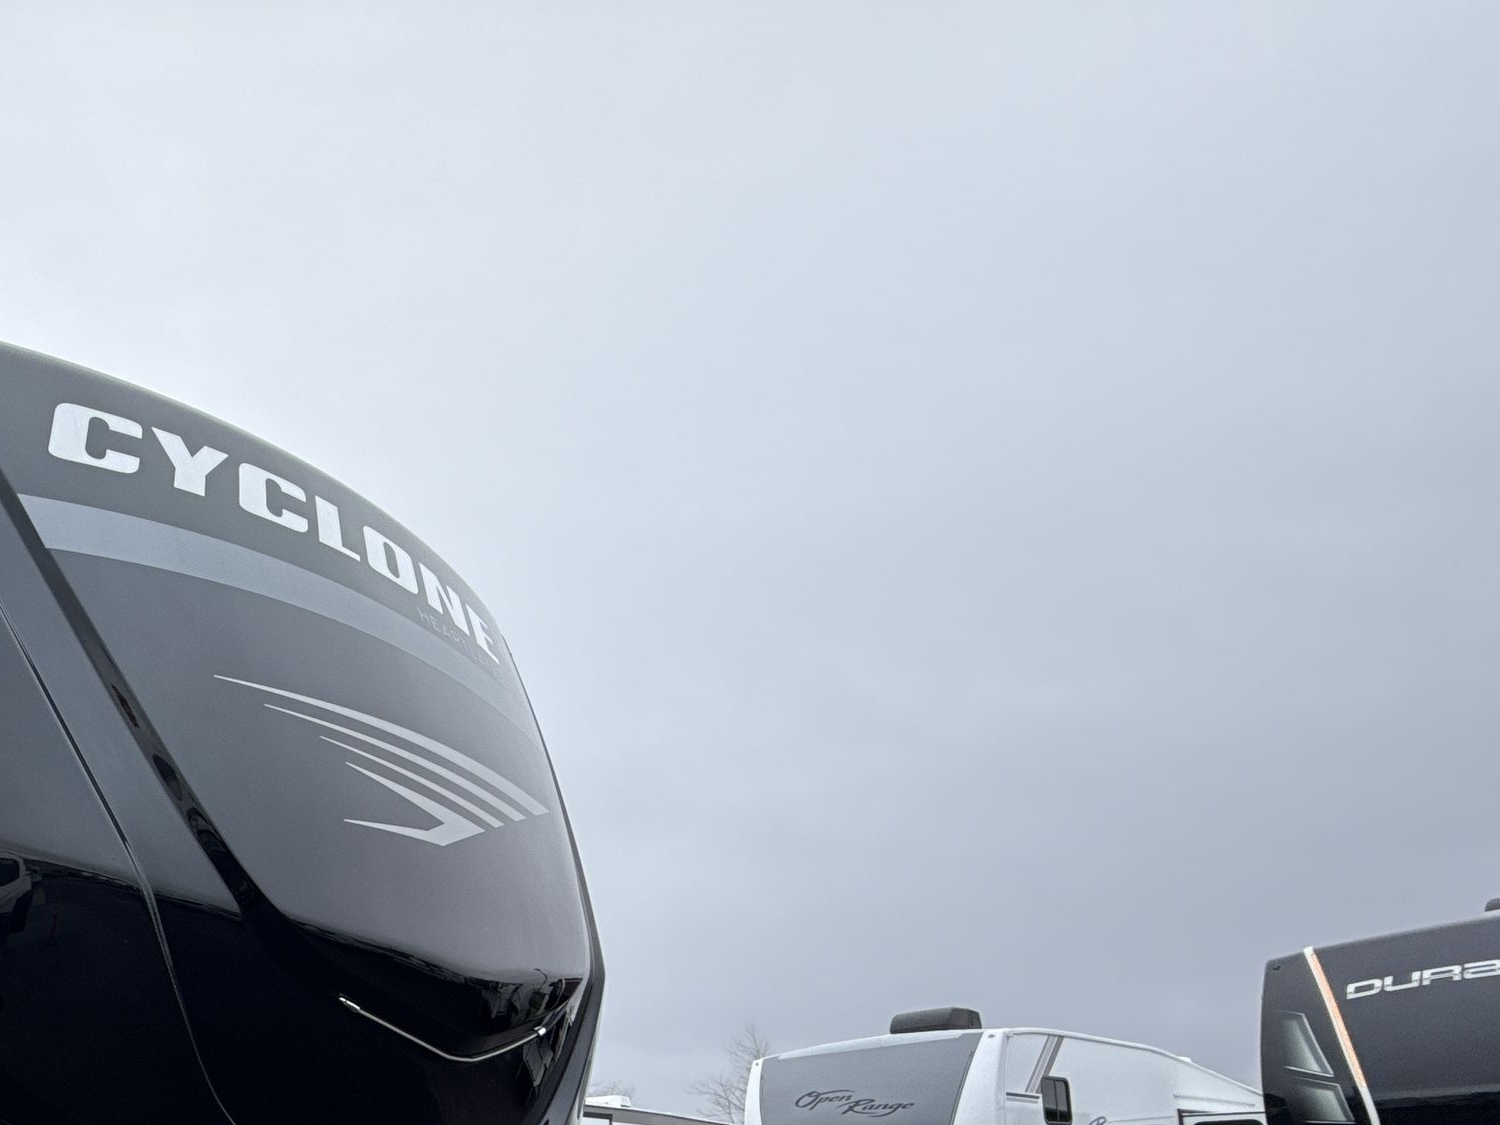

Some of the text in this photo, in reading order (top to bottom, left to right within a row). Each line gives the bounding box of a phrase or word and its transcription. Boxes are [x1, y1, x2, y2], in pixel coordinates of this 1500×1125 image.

[48, 402, 499, 664] CYCLONE
[795, 1089, 914, 1118] Open Range
